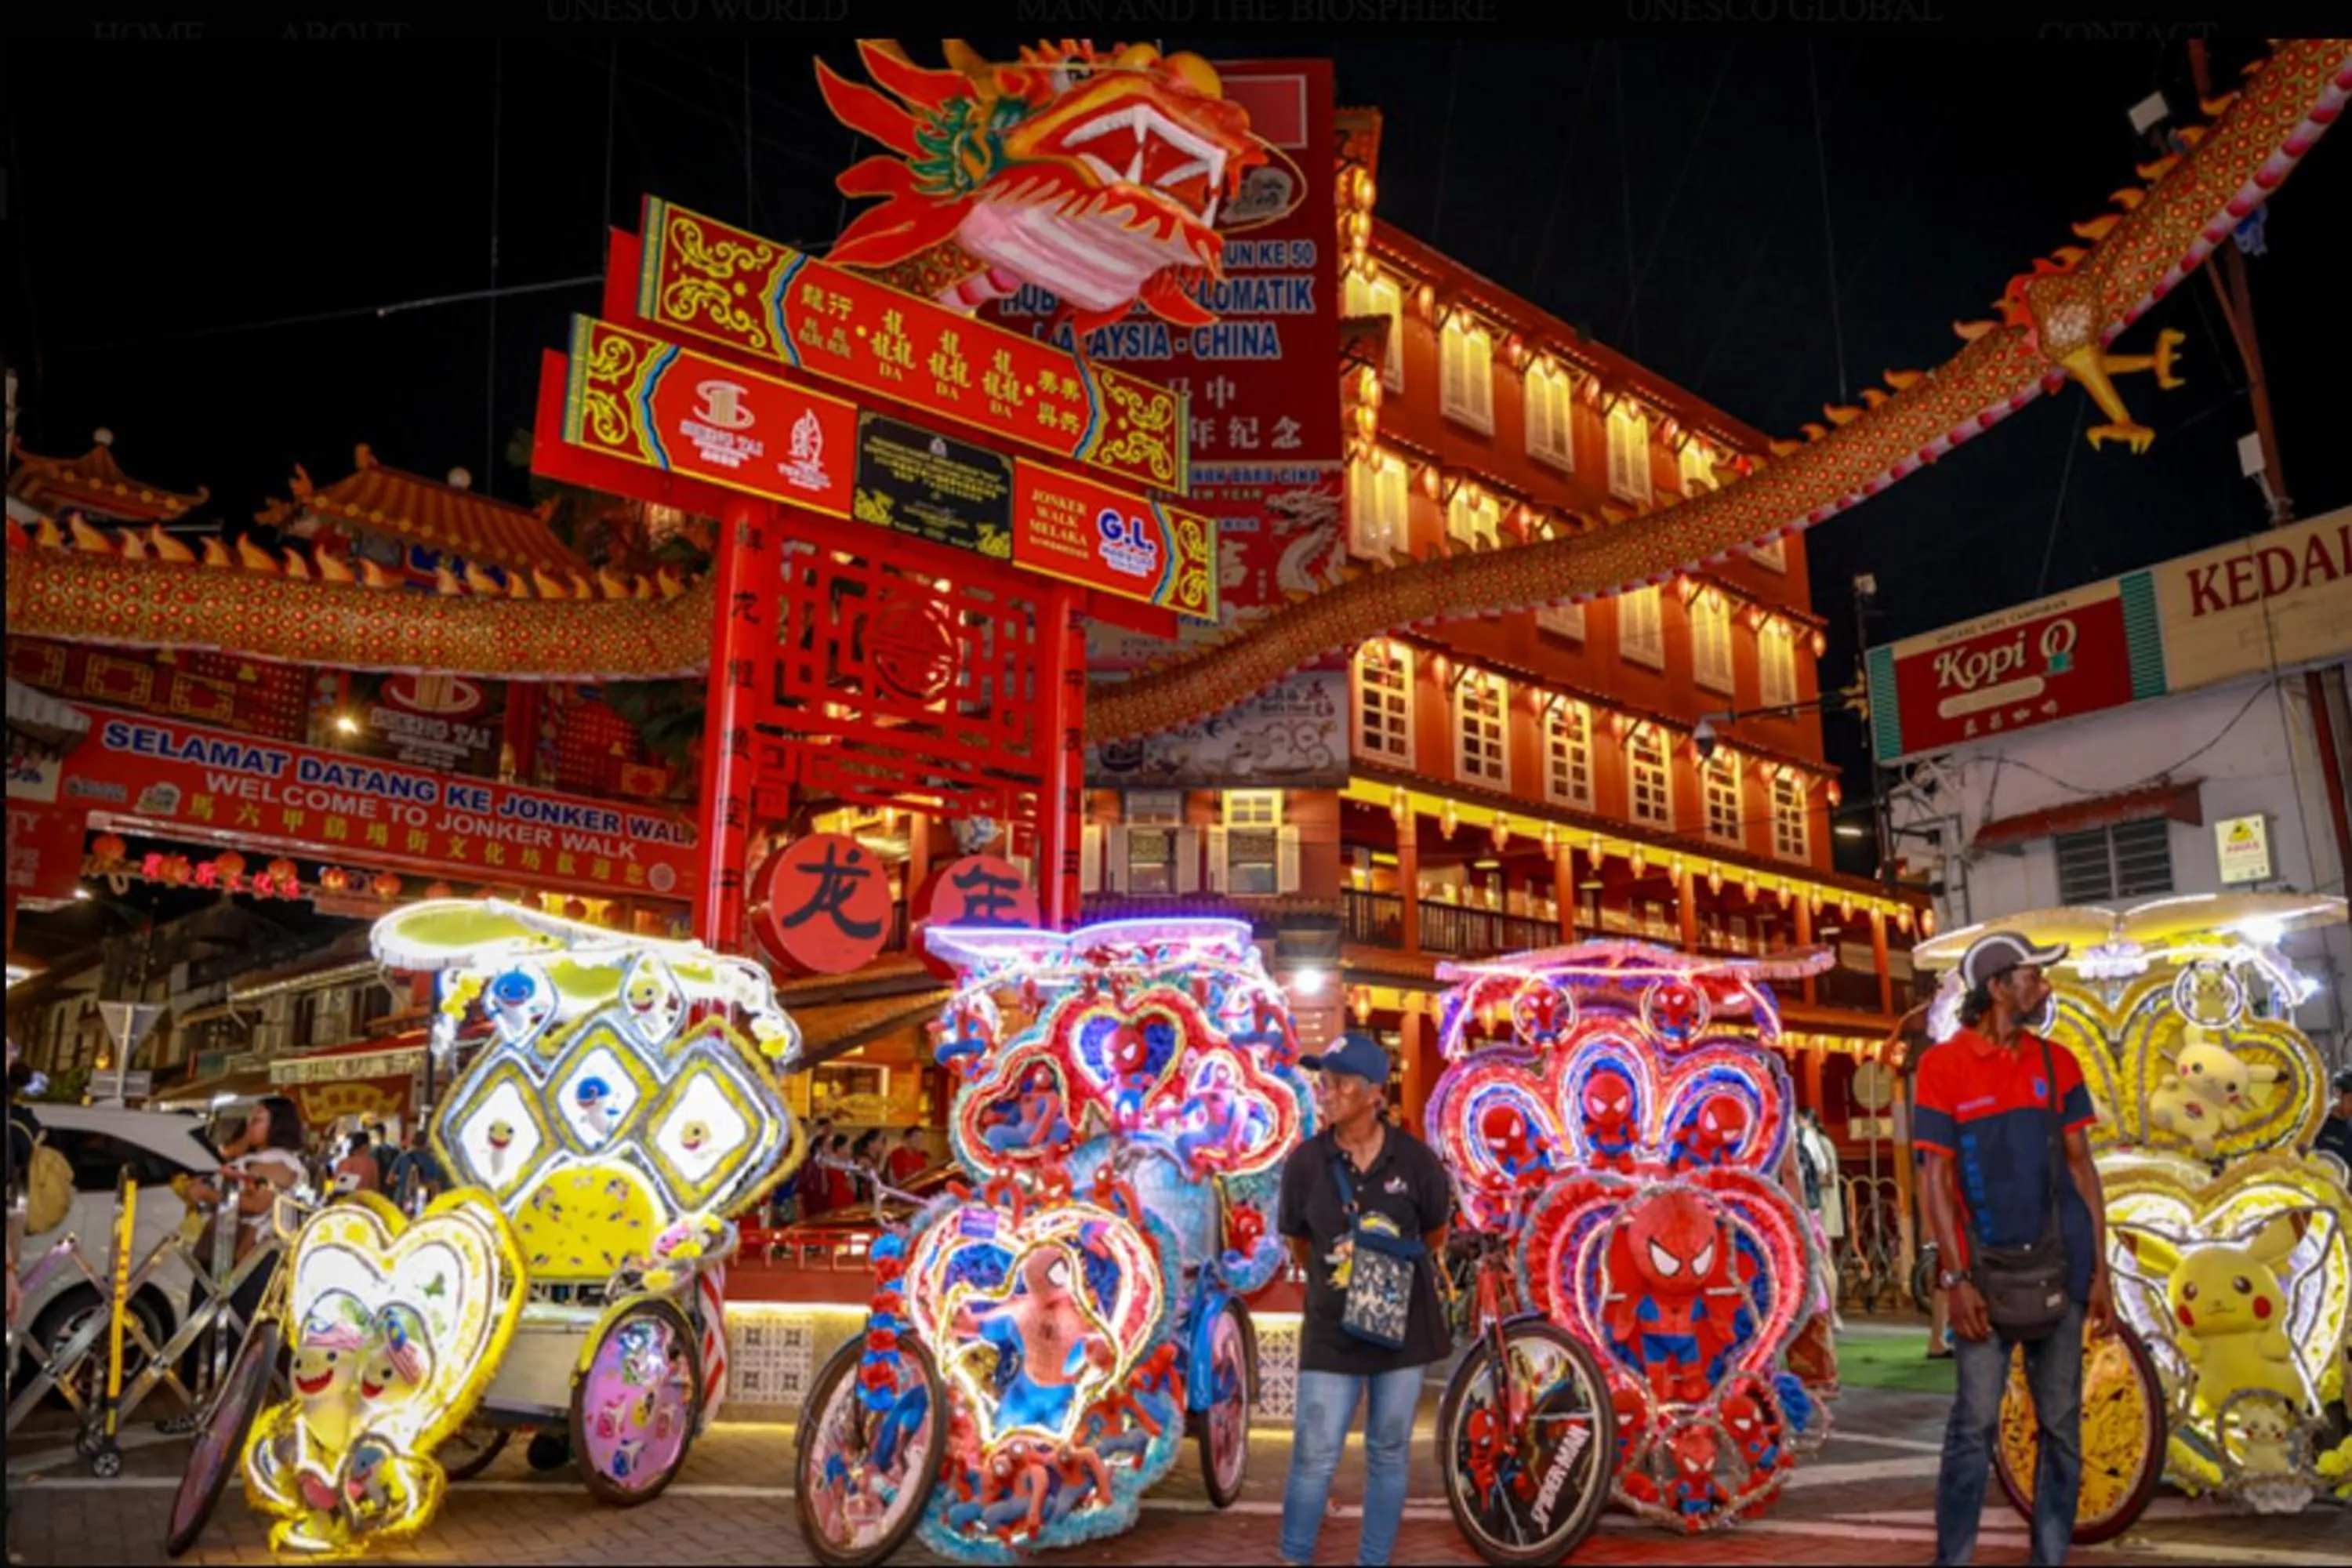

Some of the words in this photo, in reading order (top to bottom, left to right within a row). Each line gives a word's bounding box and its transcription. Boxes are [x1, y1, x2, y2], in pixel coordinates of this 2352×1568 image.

[1257, 241, 1287, 266] KE
[1290, 241, 1315, 266] 50
[1195, 277, 1316, 314] LOMATIK
[1192, 321, 1282, 360] CHINA
[1031, 488, 1087, 517] JONKER
[1029, 517, 1088, 547] MELAKA
[1098, 509, 1156, 554] G.L.
[1933, 630, 2027, 691] Kopi
[104, 721, 291, 776] SELAMAT
[298, 757, 437, 804] DATANG
[446, 785, 492, 815] KE
[500, 793, 622, 836] JONKER
[206, 771, 377, 819] WELCOME
[390, 802, 429, 828] TO
[436, 811, 553, 848] JONKER
[560, 832, 638, 862] WALK
[782, 841, 883, 940] 龙
